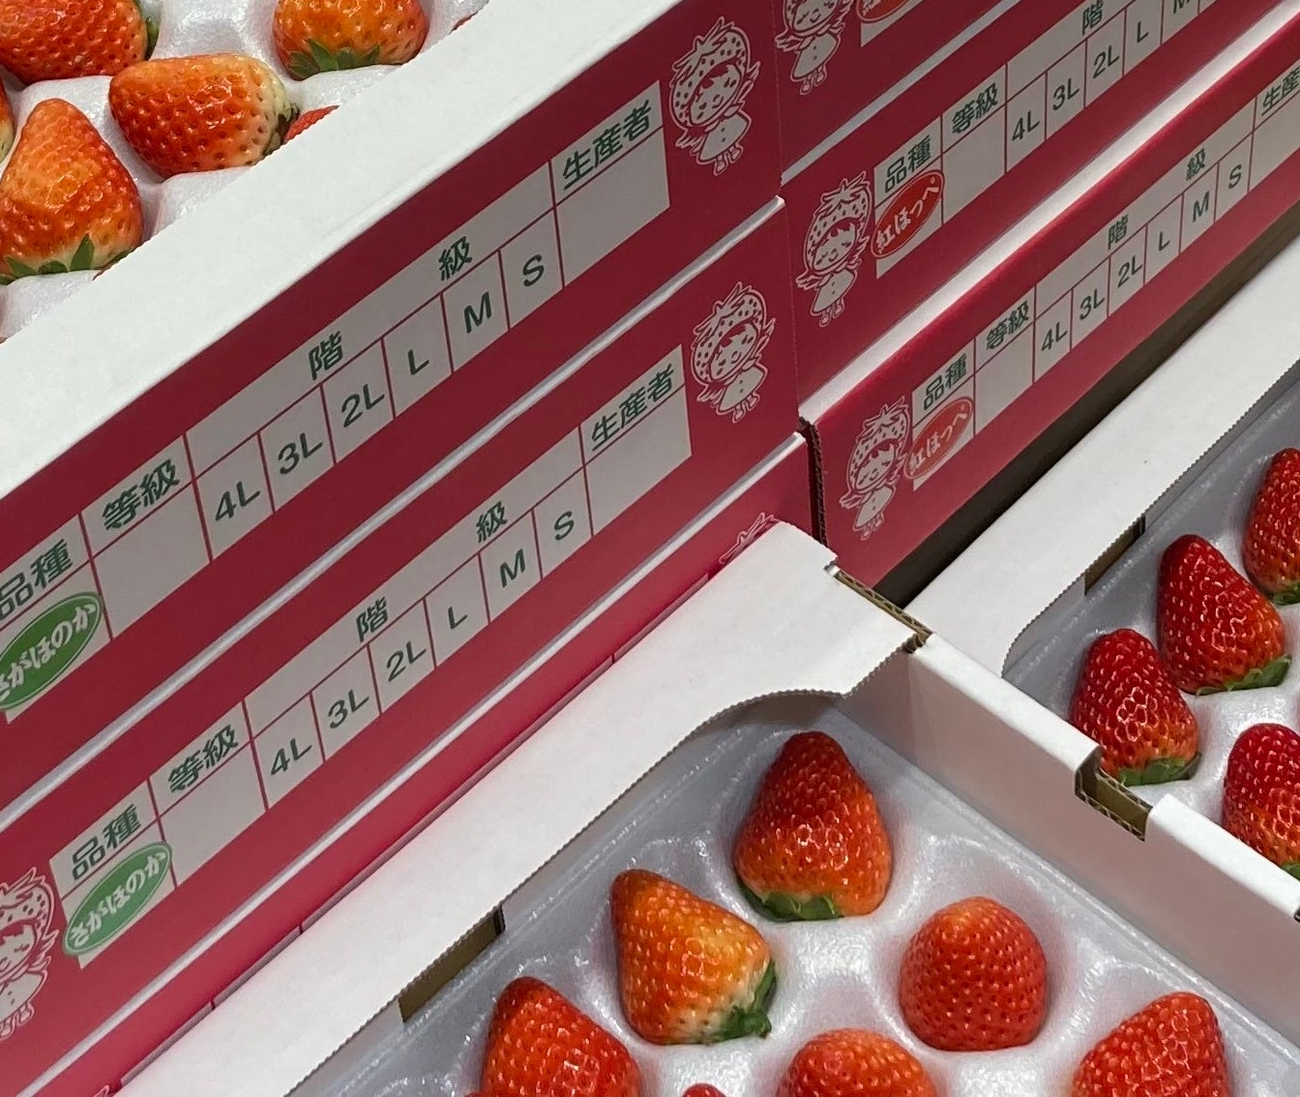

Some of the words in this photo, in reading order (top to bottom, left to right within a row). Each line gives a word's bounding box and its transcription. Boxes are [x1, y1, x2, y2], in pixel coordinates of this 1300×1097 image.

[884, 134, 931, 193] 品種
[951, 86, 999, 135] 等級
[1080, 0, 1104, 36] 階
[1011, 110, 1040, 142] 4L
[1052, 81, 1080, 111] 3L
[1092, 48, 1120, 78] 2L
[1135, 21, 1149, 43] L
[876, 176, 938, 252] 紅ほっぺ
[923, 356, 967, 410] 品種
[985, 302, 1030, 351] 等級
[1106, 213, 1128, 251] 階
[1185, 148, 1206, 181] 級
[1041, 319, 1067, 351] 4L
[1079, 288, 1105, 321] 3L
[1117, 256, 1143, 287] 2L
[1157, 228, 1170, 251] L
[1192, 192, 1210, 223] M
[1227, 164, 1242, 188] S
[100, 458, 181, 530] 等級
[307, 331, 343, 380] 階
[438, 234, 473, 282] 級
[561, 99, 651, 186] 生産者
[214, 481, 261, 524] 4L
[277, 433, 322, 475] 3L
[340, 384, 385, 428] 2L
[407, 350, 430, 377] L
[464, 291, 493, 334] M
[521, 255, 544, 287] S
[906, 405, 970, 469] 紅ほっぺ
[71, 805, 142, 882] 品種
[168, 725, 240, 794] 等級
[356, 597, 388, 641] 階
[474, 503, 507, 545] 級
[590, 364, 676, 450] 生産者
[268, 736, 313, 778] 4L
[326, 691, 370, 729] 3L
[384, 643, 427, 682] 2L
[446, 605, 468, 630] L
[500, 549, 529, 588] M
[553, 511, 576, 540] S
[68, 846, 168, 953] さがほのか
